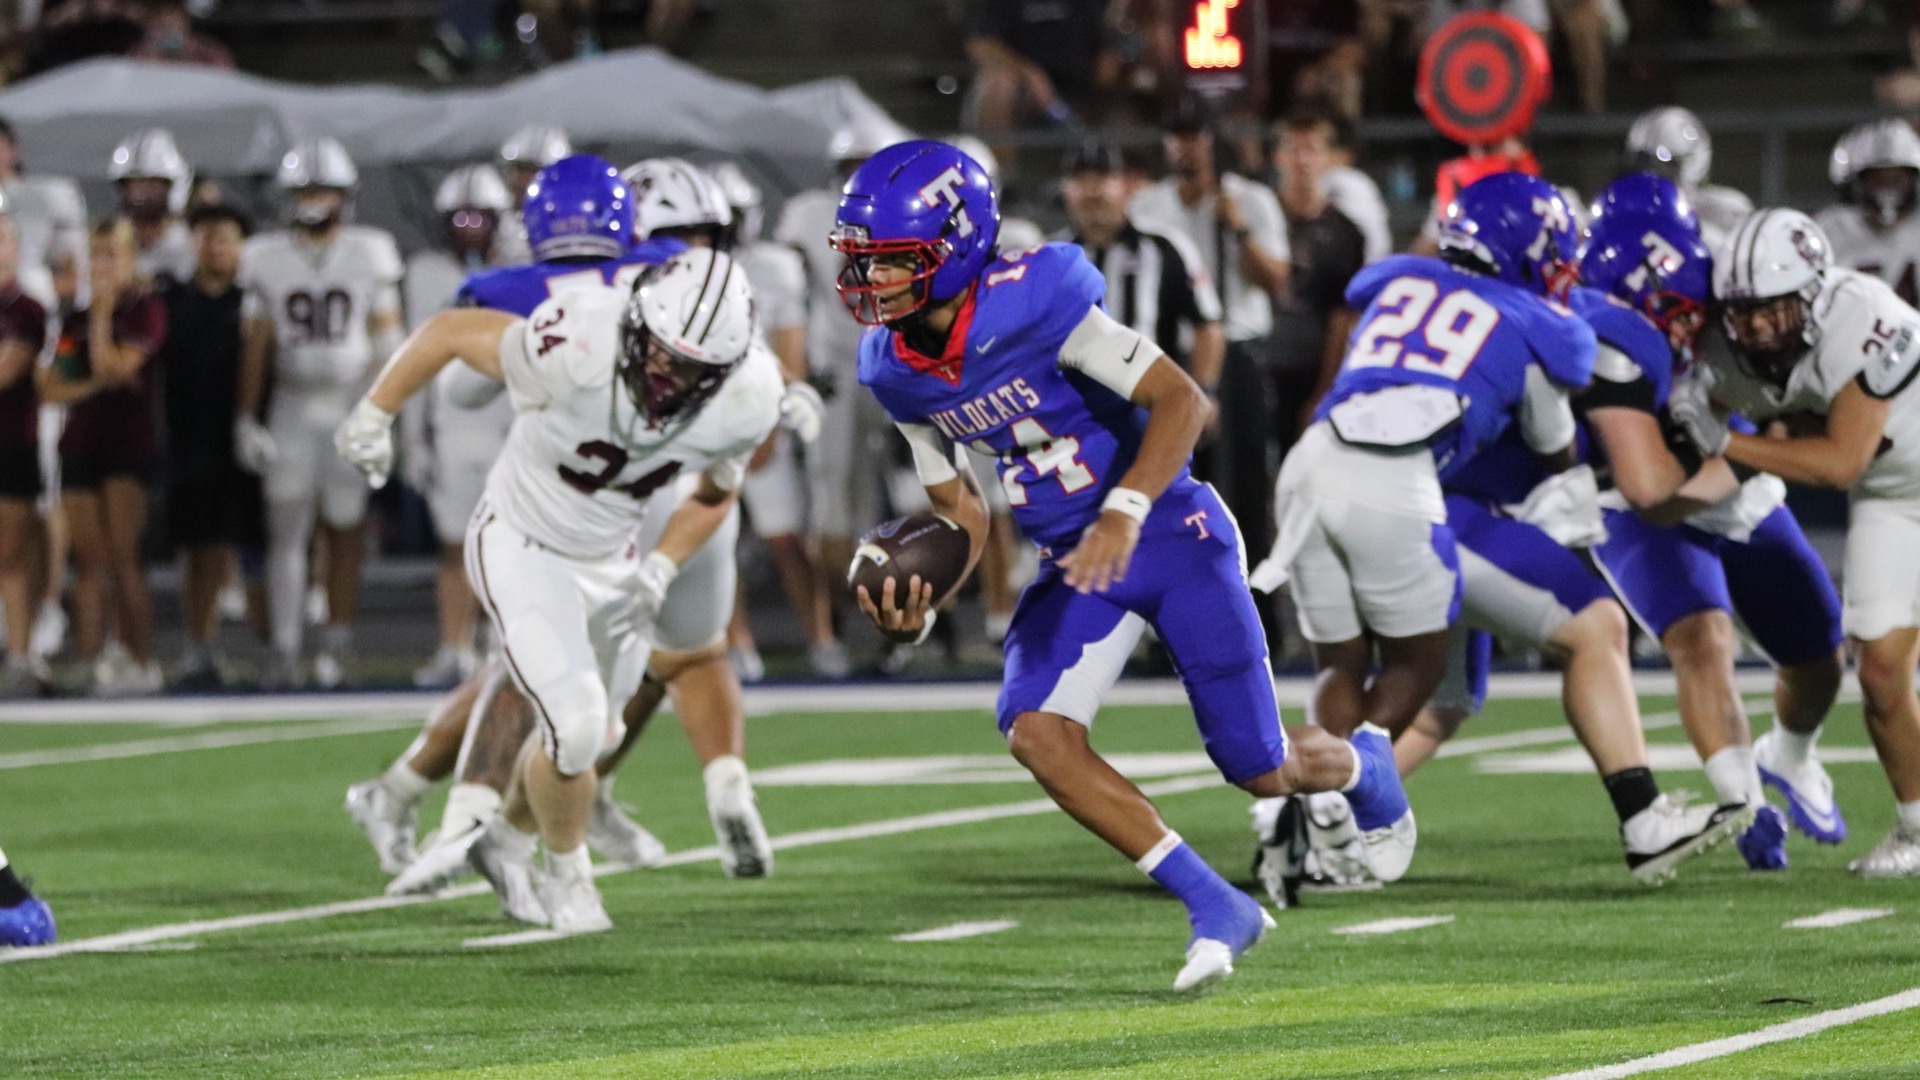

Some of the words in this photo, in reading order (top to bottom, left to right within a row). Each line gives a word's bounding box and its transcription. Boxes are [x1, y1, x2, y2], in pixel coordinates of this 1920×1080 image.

[918, 166, 973, 239] T
[1624, 230, 1686, 293] T
[286, 288, 352, 345] 90
[533, 307, 567, 357] 34
[1347, 275, 1500, 382] 29
[1184, 510, 1210, 540] T
